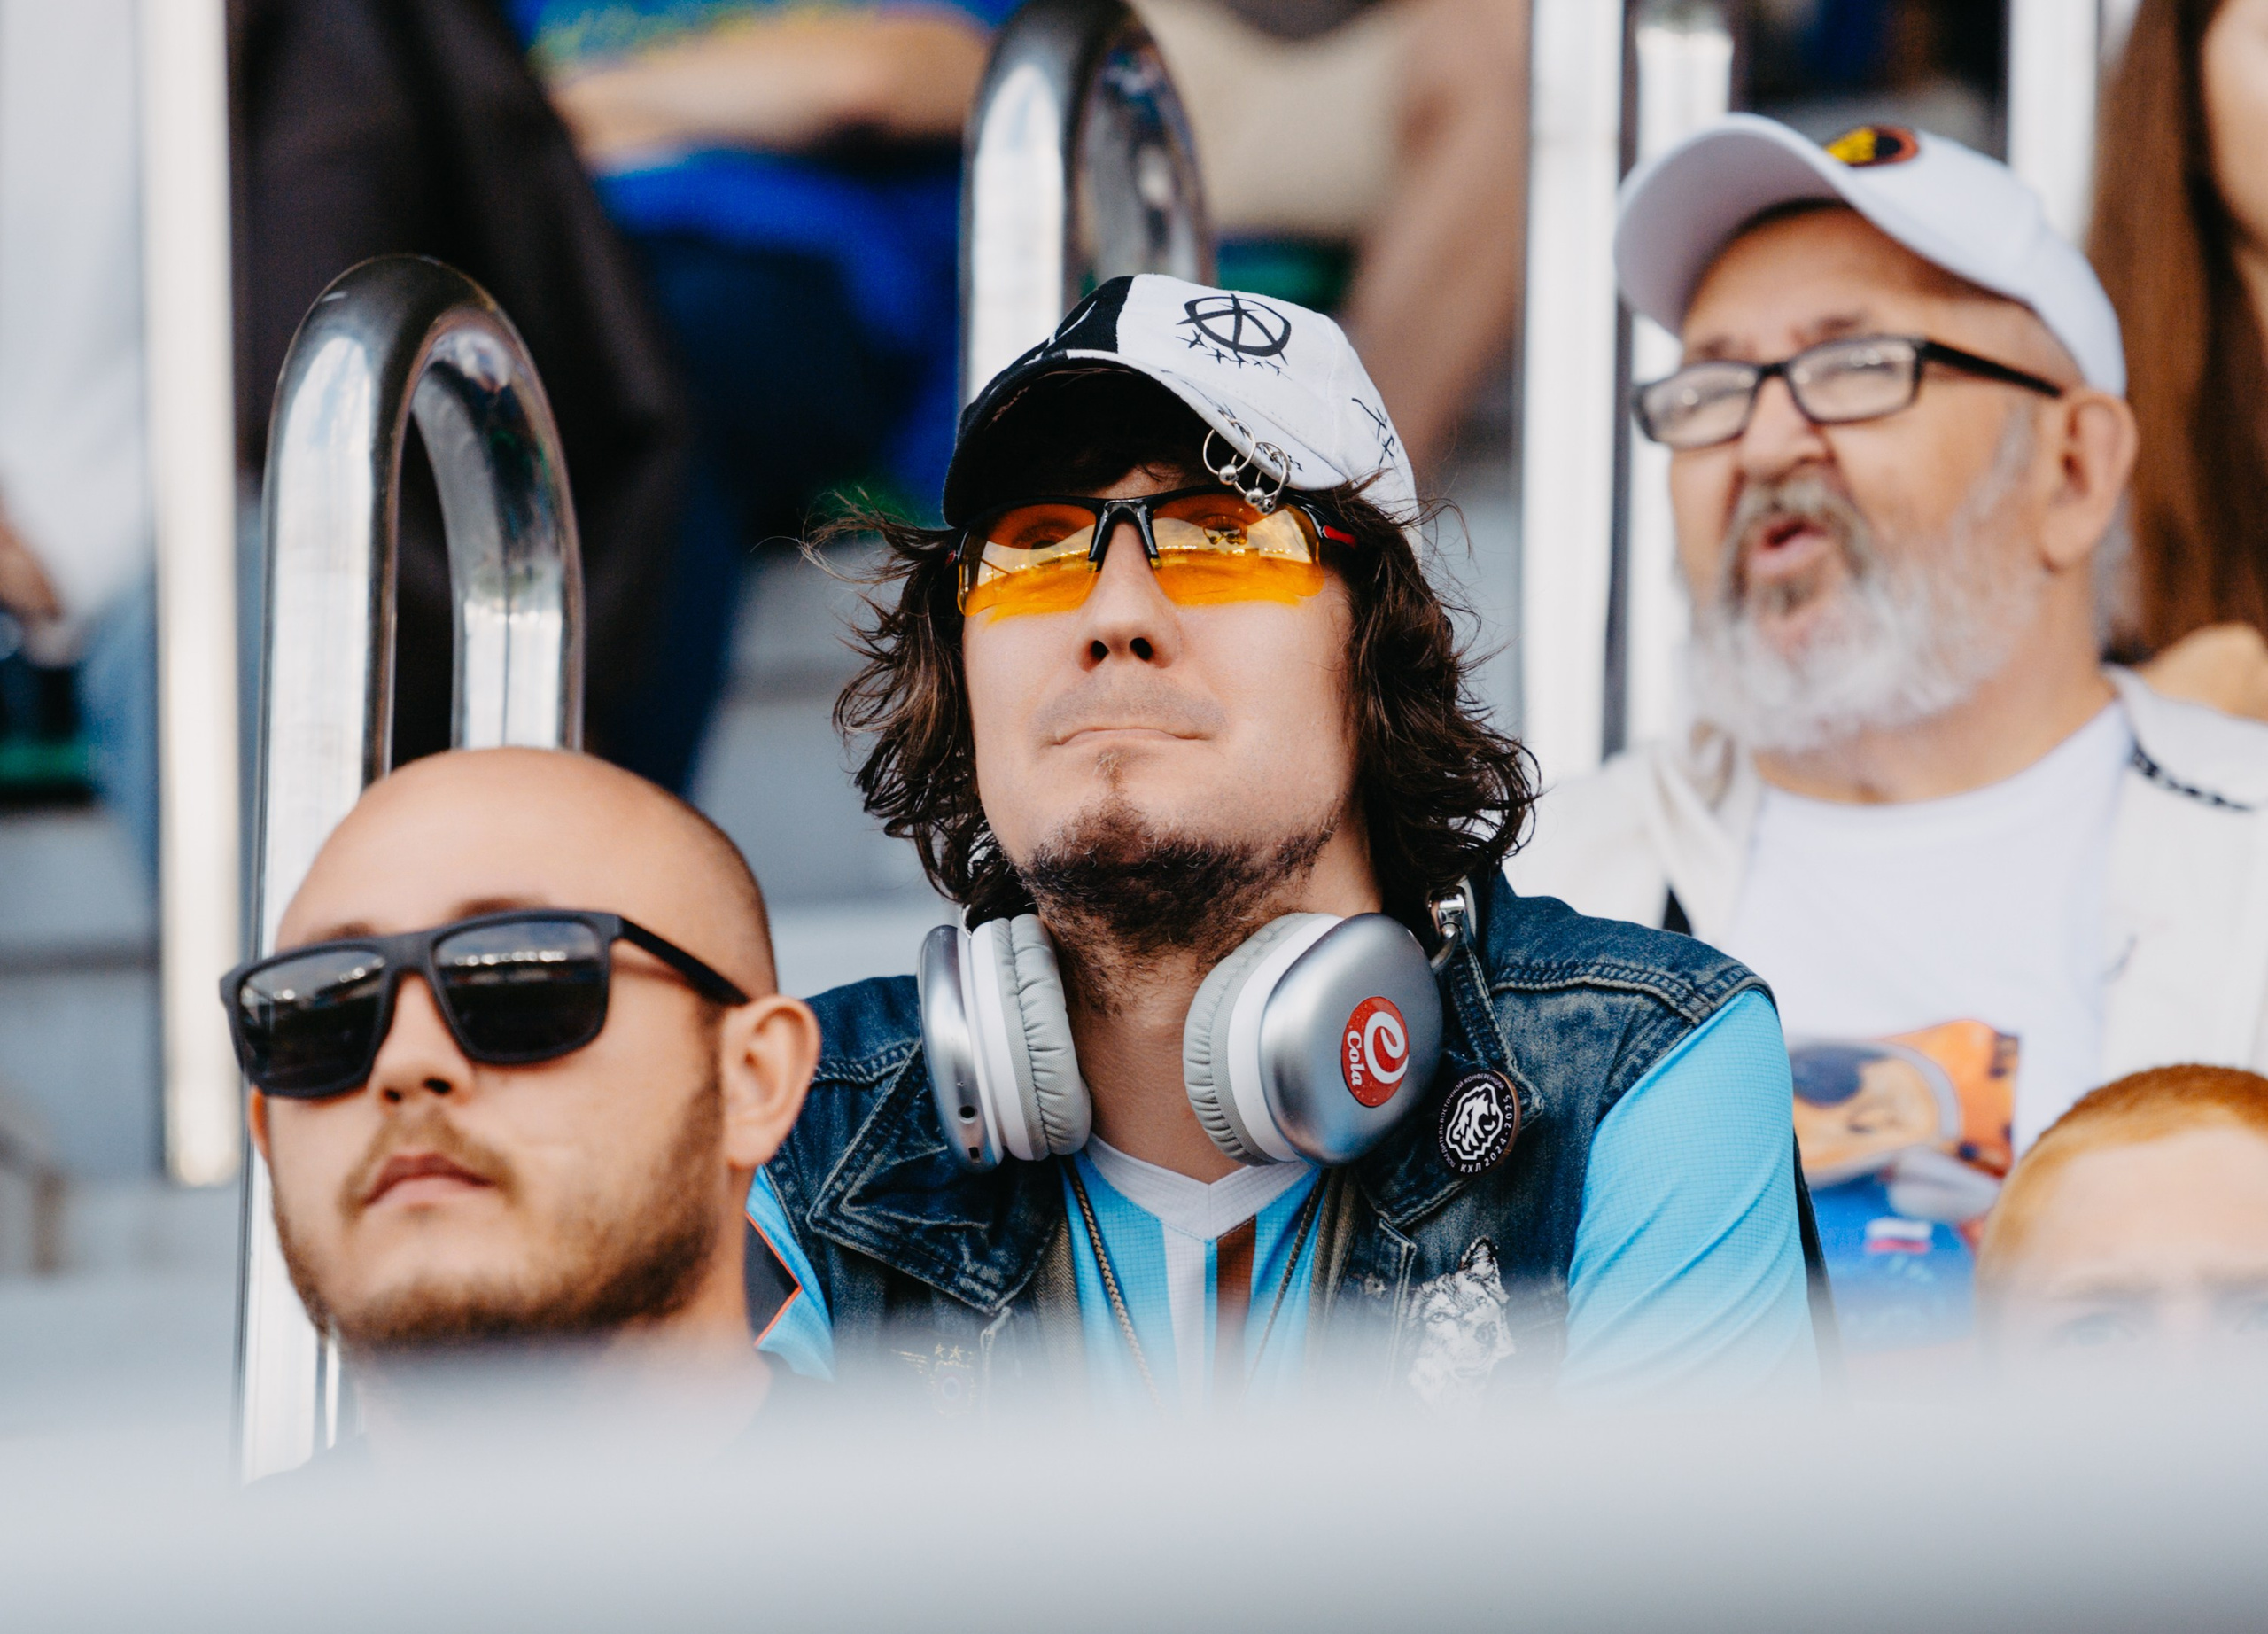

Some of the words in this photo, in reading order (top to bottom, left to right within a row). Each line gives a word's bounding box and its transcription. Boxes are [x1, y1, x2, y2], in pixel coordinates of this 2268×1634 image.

[1347, 1030, 1365, 1086] Cola
[1439, 1080, 1464, 1124] ВОСТОЧНОЙ
[1464, 1072, 1505, 1090] КОНФЕРЕНЦИИ
[1438, 1124, 1456, 1168] ПОБЕДИТЕЛЬ
[1460, 1163, 1481, 1173] КХЛ
